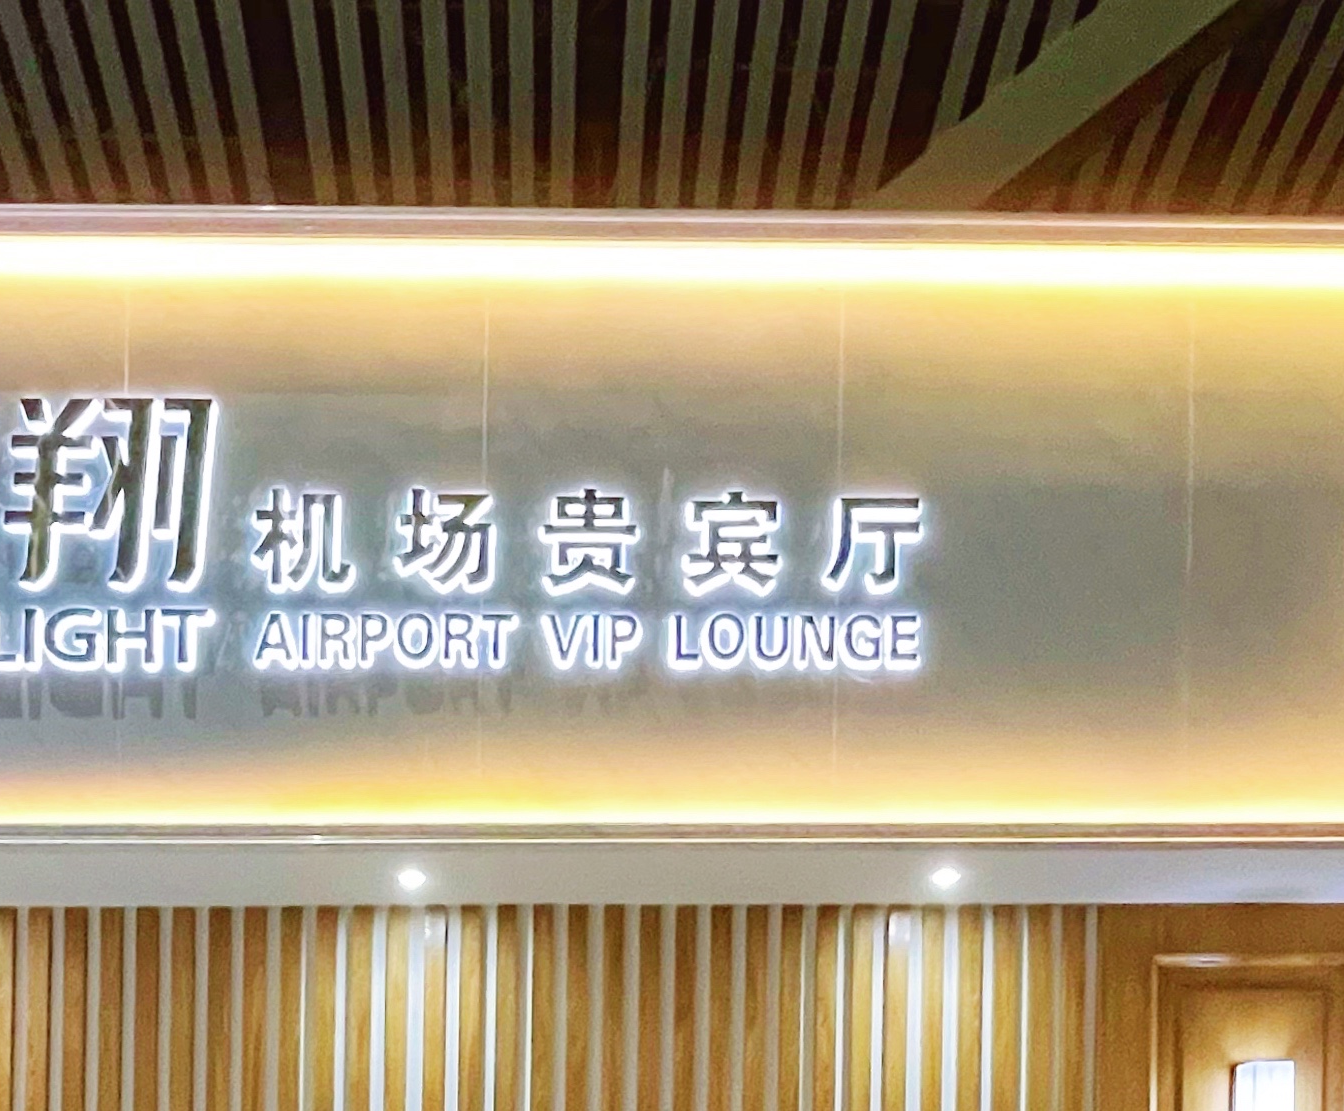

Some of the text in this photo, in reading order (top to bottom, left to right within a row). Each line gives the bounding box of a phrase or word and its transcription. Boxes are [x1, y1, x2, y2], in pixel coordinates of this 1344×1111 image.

[253, 486, 923, 597] 机场贵宾厅
[254, 612, 518, 674] AIRPORT
[541, 612, 643, 674] VIP
[665, 612, 923, 676] LOUNGE
